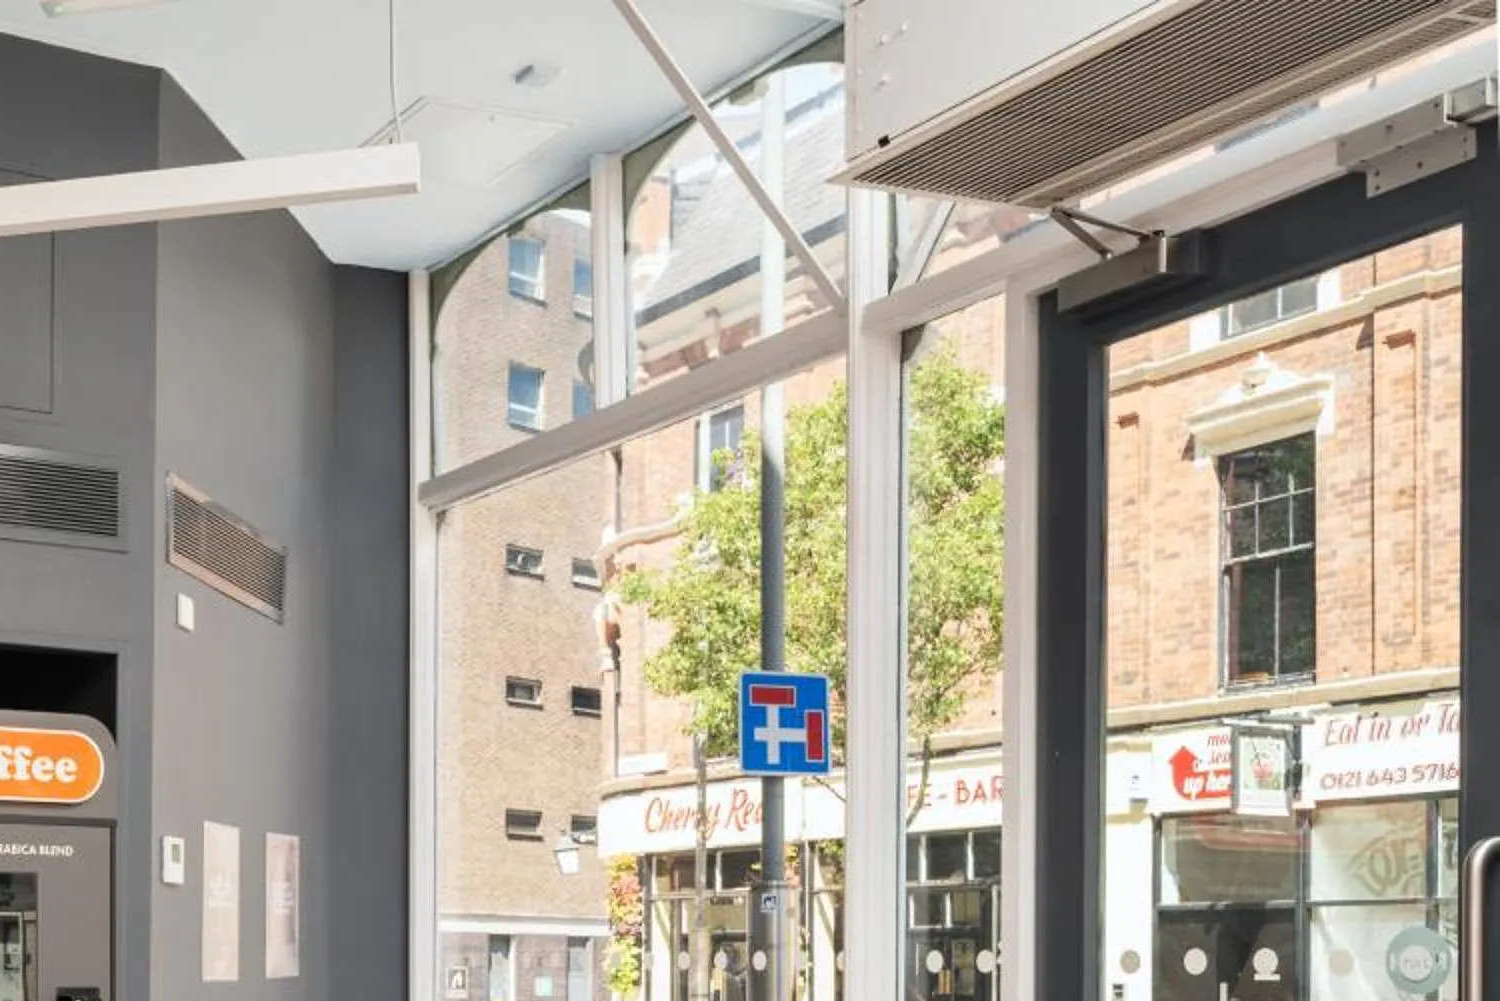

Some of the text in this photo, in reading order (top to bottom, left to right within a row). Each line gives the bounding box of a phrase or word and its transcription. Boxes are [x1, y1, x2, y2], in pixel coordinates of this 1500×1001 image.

[1369, 711, 1393, 741] in
[1401, 713, 1431, 738] or
[1320, 770, 1362, 790] 0121
[1366, 766, 1408, 786] 643
